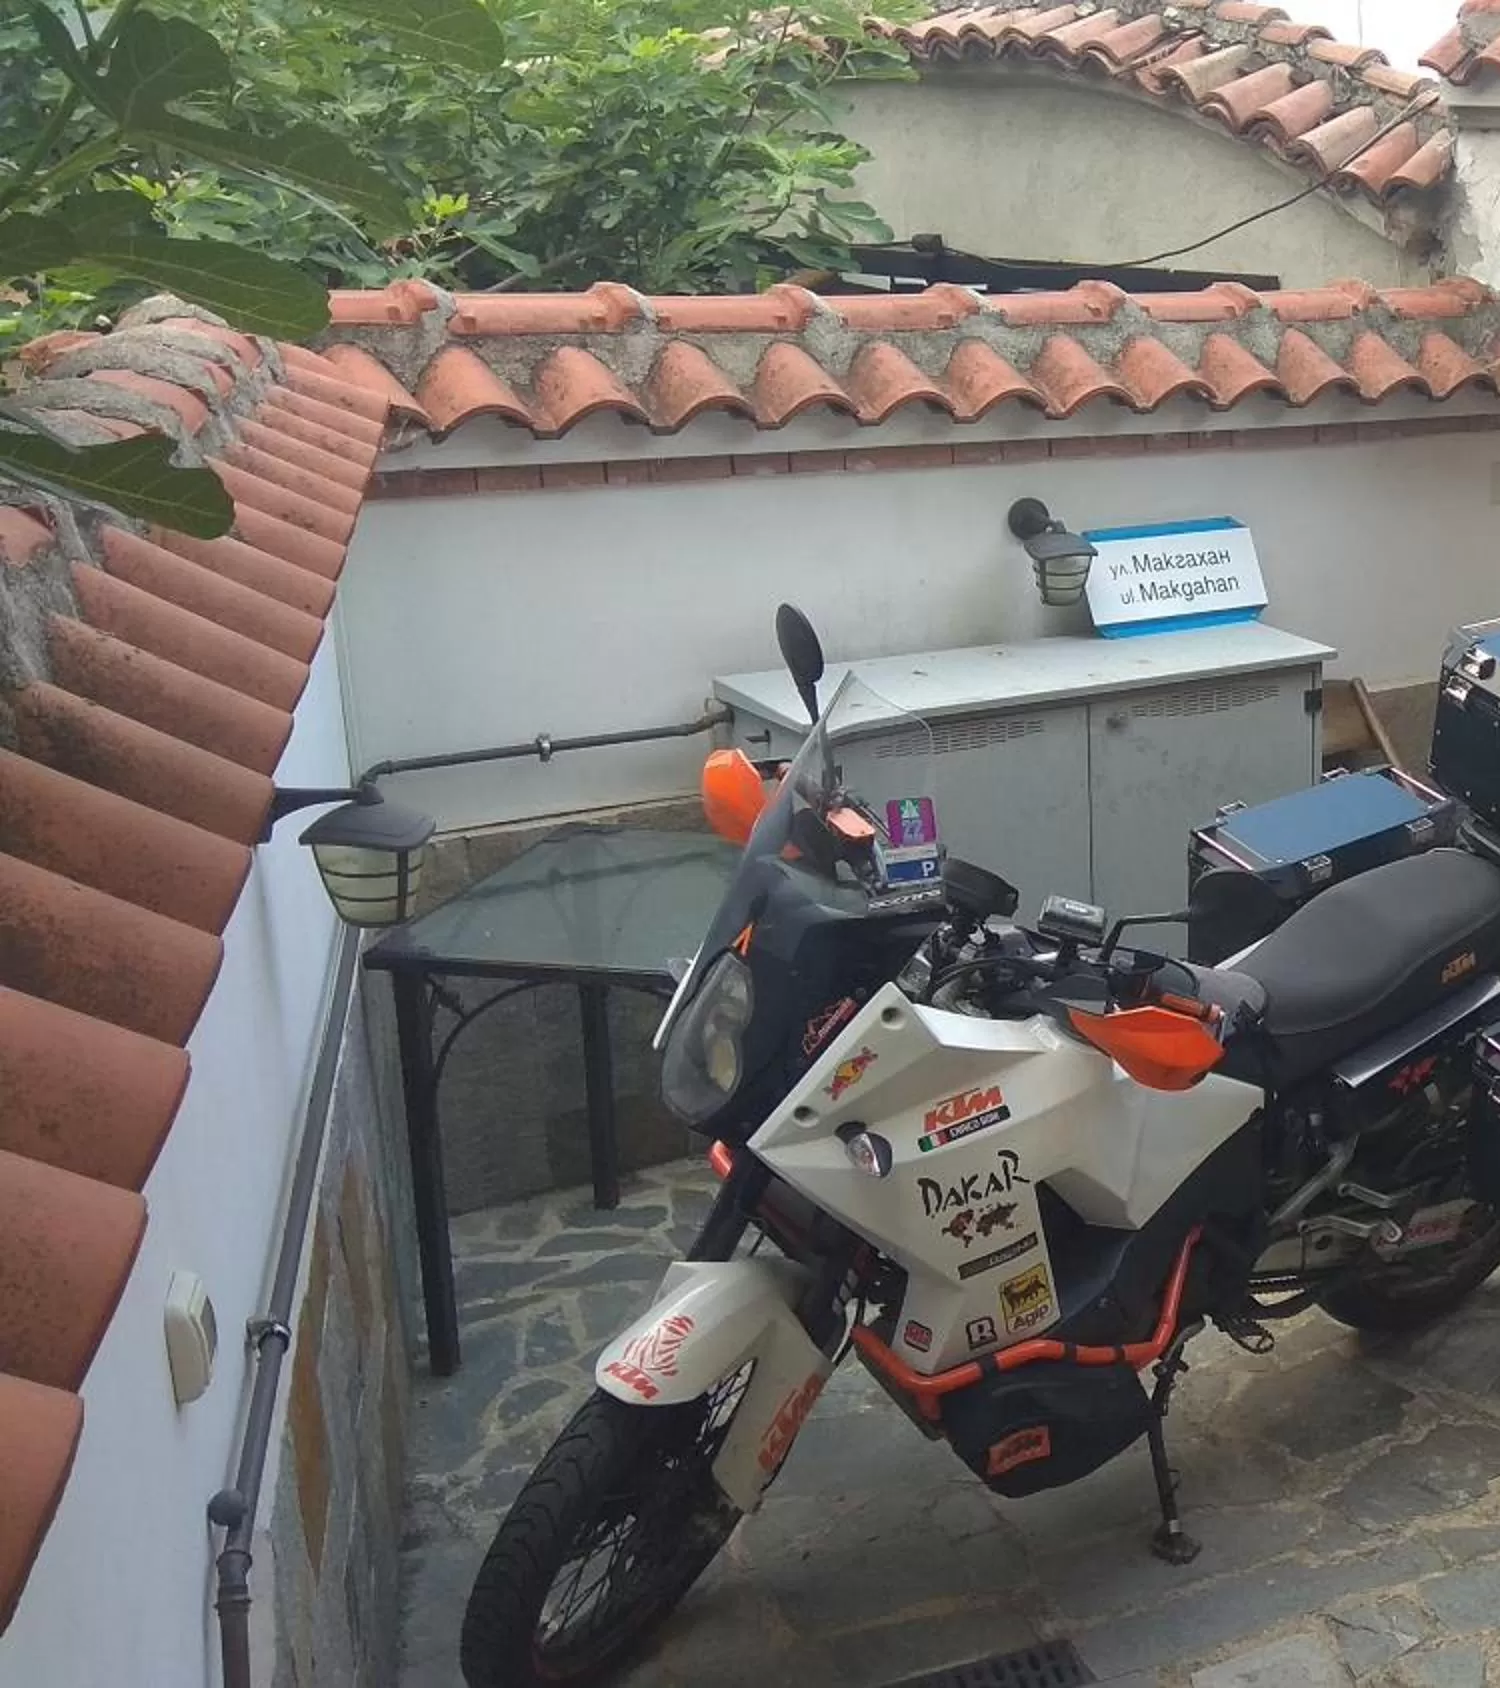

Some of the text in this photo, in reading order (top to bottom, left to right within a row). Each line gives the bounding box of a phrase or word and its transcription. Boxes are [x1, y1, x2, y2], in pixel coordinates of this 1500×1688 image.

[921, 861, 935, 877] P
[924, 1086, 1003, 1133] KTM
[917, 1149, 1030, 1218] DAKAR
[1013, 1303, 1050, 1331] Agip
[603, 1362, 662, 1400] KTM
